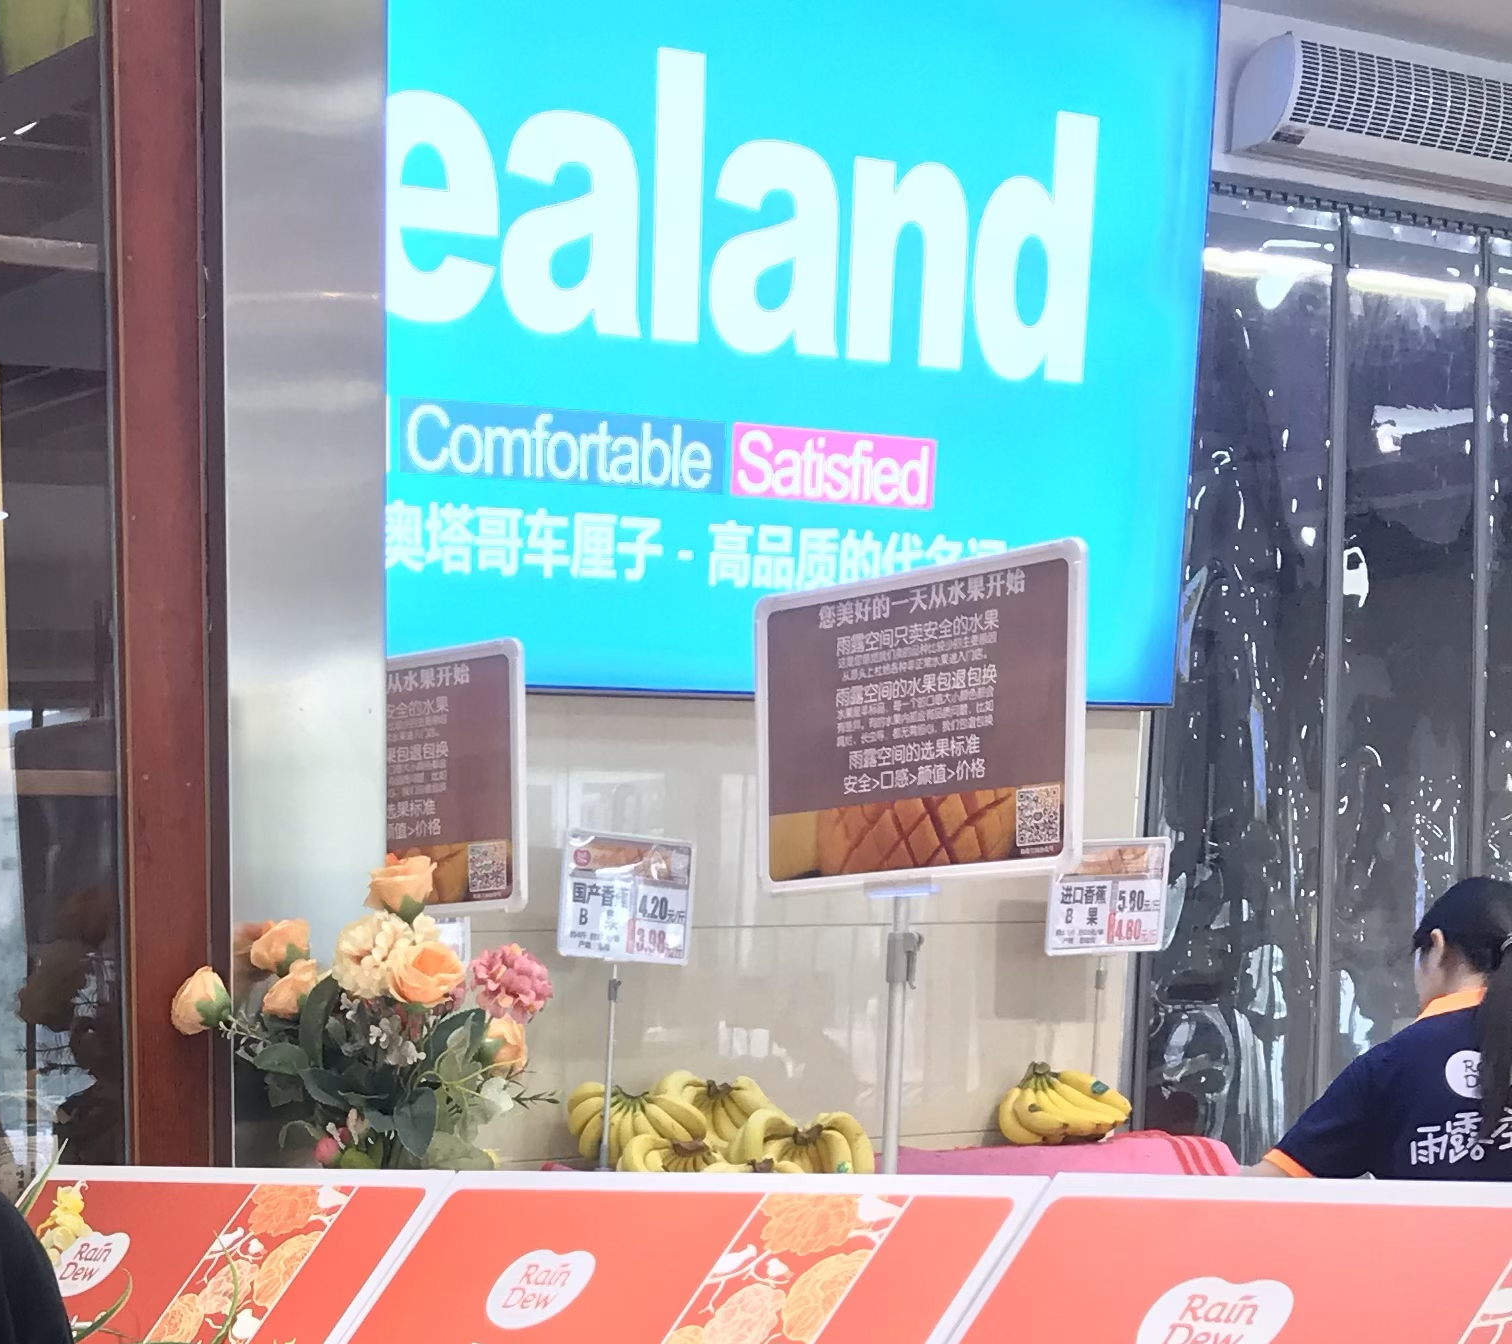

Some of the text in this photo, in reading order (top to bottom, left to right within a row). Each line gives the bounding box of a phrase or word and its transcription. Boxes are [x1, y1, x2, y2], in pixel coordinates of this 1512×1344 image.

[386, 46, 1100, 384] ealand
[406, 404, 929, 506] Comfortable Satisfied
[819, 568, 1027, 629] 您美好的一天从水果开始
[837, 608, 999, 657] 雨露空间只卖安全的水果
[836, 663, 998, 708] 雨露空间的水果包退包换
[849, 733, 981, 771] 雨露空间的选果标准
[59, 1262, 100, 1281] Dew
[519, 1263, 572, 1287] Rain
[502, 1287, 558, 1310] Dew
[1178, 1294, 1258, 1325] Rain
